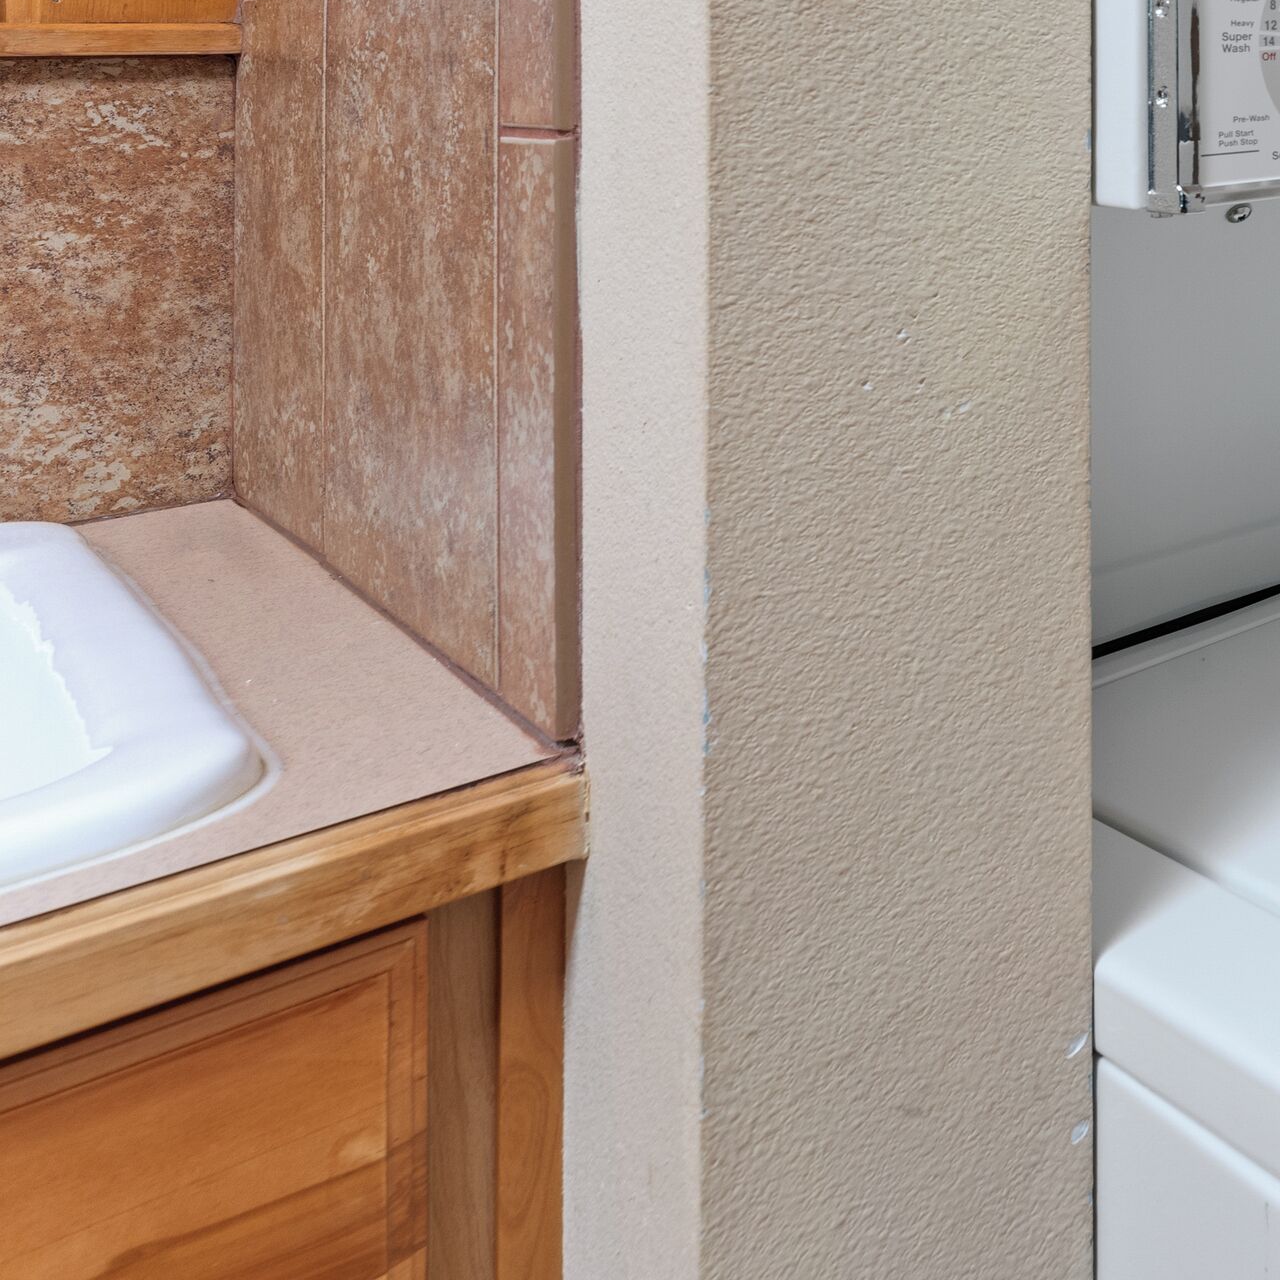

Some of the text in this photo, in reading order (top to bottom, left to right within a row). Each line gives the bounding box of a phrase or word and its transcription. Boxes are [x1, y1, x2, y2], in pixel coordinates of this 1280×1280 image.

[1270, 0, 1276, 10] 8
[1265, 20, 1277, 30] 12
[1222, 32, 1252, 41] Super
[1263, 37, 1275, 46] 14
[1222, 44, 1250, 53] Wash
[1262, 52, 1276, 61] Off
[1233, 115, 1270, 123] Pre-Wash
[1235, 129, 1254, 138] Start
[1240, 138, 1258, 146] Stop
